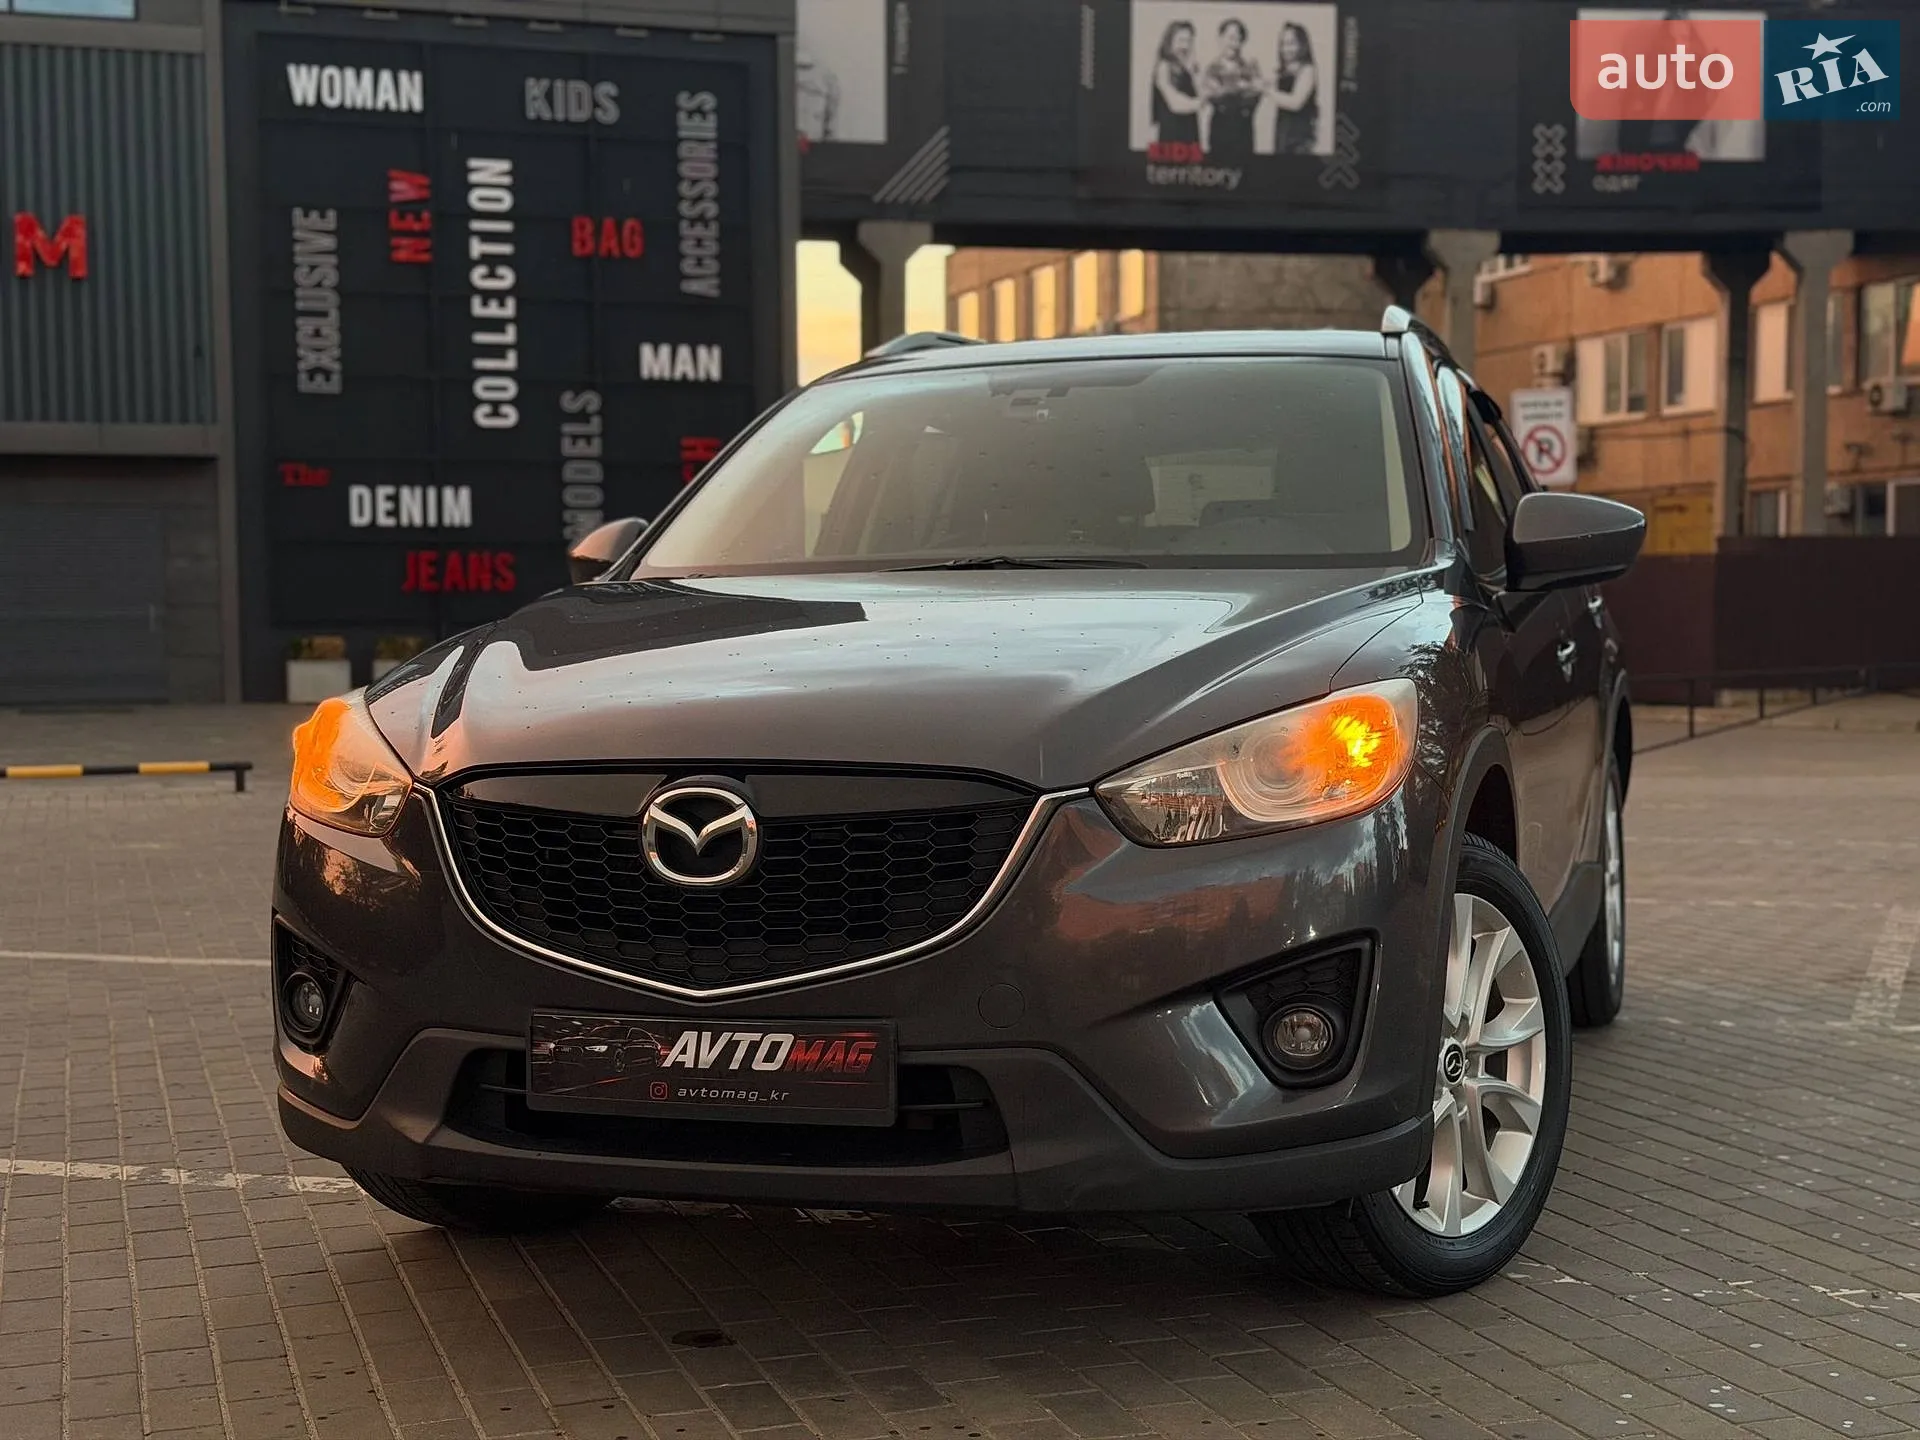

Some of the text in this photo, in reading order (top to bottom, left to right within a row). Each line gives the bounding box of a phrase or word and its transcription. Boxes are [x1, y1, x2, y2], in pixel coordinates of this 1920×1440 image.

[287, 63, 423, 113] WOMAN
[525, 77, 620, 125] KIDS
[1147, 142, 1204, 163] KIDS
[676, 90, 720, 297] ACCESSORIES
[1146, 164, 1242, 190] territory
[389, 170, 432, 264] NEW
[572, 215, 645, 259] BAG
[14, 212, 87, 279] M
[292, 207, 342, 394] EXCLUSIVE
[467, 157, 519, 428] COLLECTION
[640, 343, 722, 382] MAN
[280, 462, 330, 487] The
[349, 484, 472, 527] DENIM
[402, 551, 517, 592] JEANS
[661, 1031, 876, 1074] AVTOMAG
[677, 1088, 792, 1103] avtomag_kr
